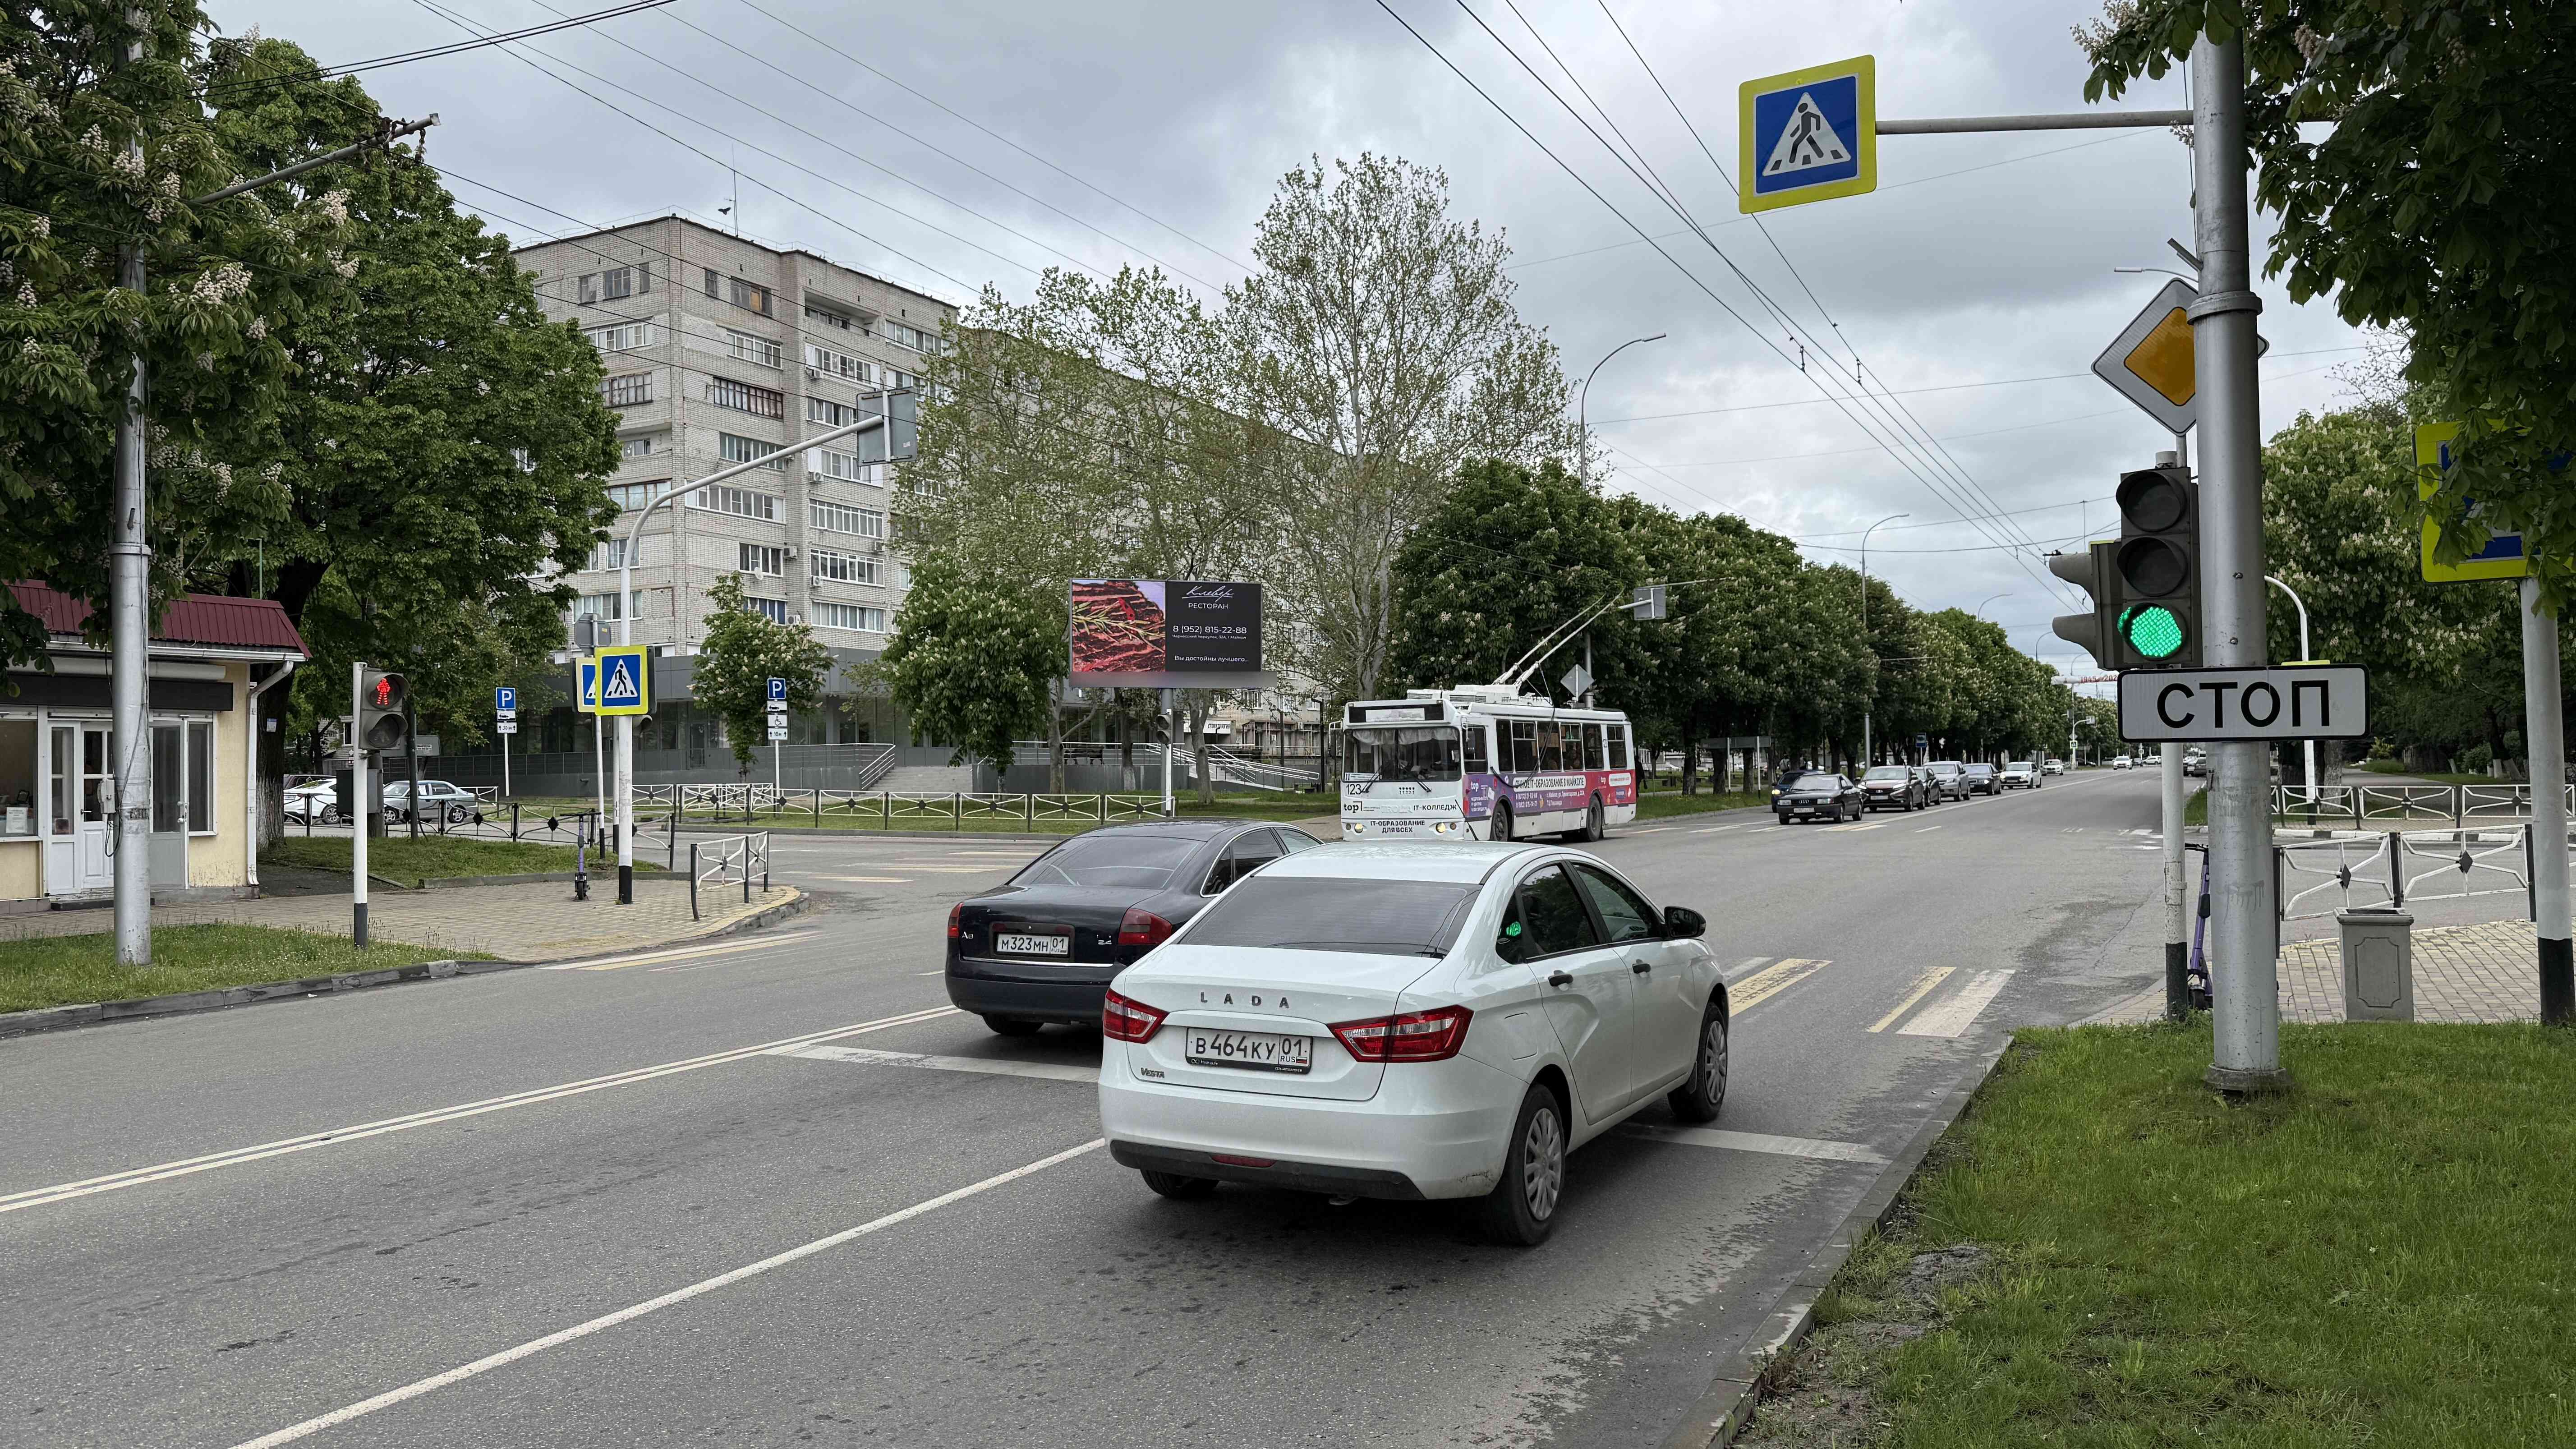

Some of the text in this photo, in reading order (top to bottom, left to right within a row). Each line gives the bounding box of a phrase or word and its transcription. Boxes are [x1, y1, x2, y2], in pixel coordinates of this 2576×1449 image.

[1182, 626, 1202, 634] (952)
[2157, 680, 2330, 728] СТОП
[1346, 784, 1362, 795] 123
[1344, 803, 1359, 813] top
[1200, 992, 1289, 1008] LADA
[1280, 1055, 1296, 1063] RUS
